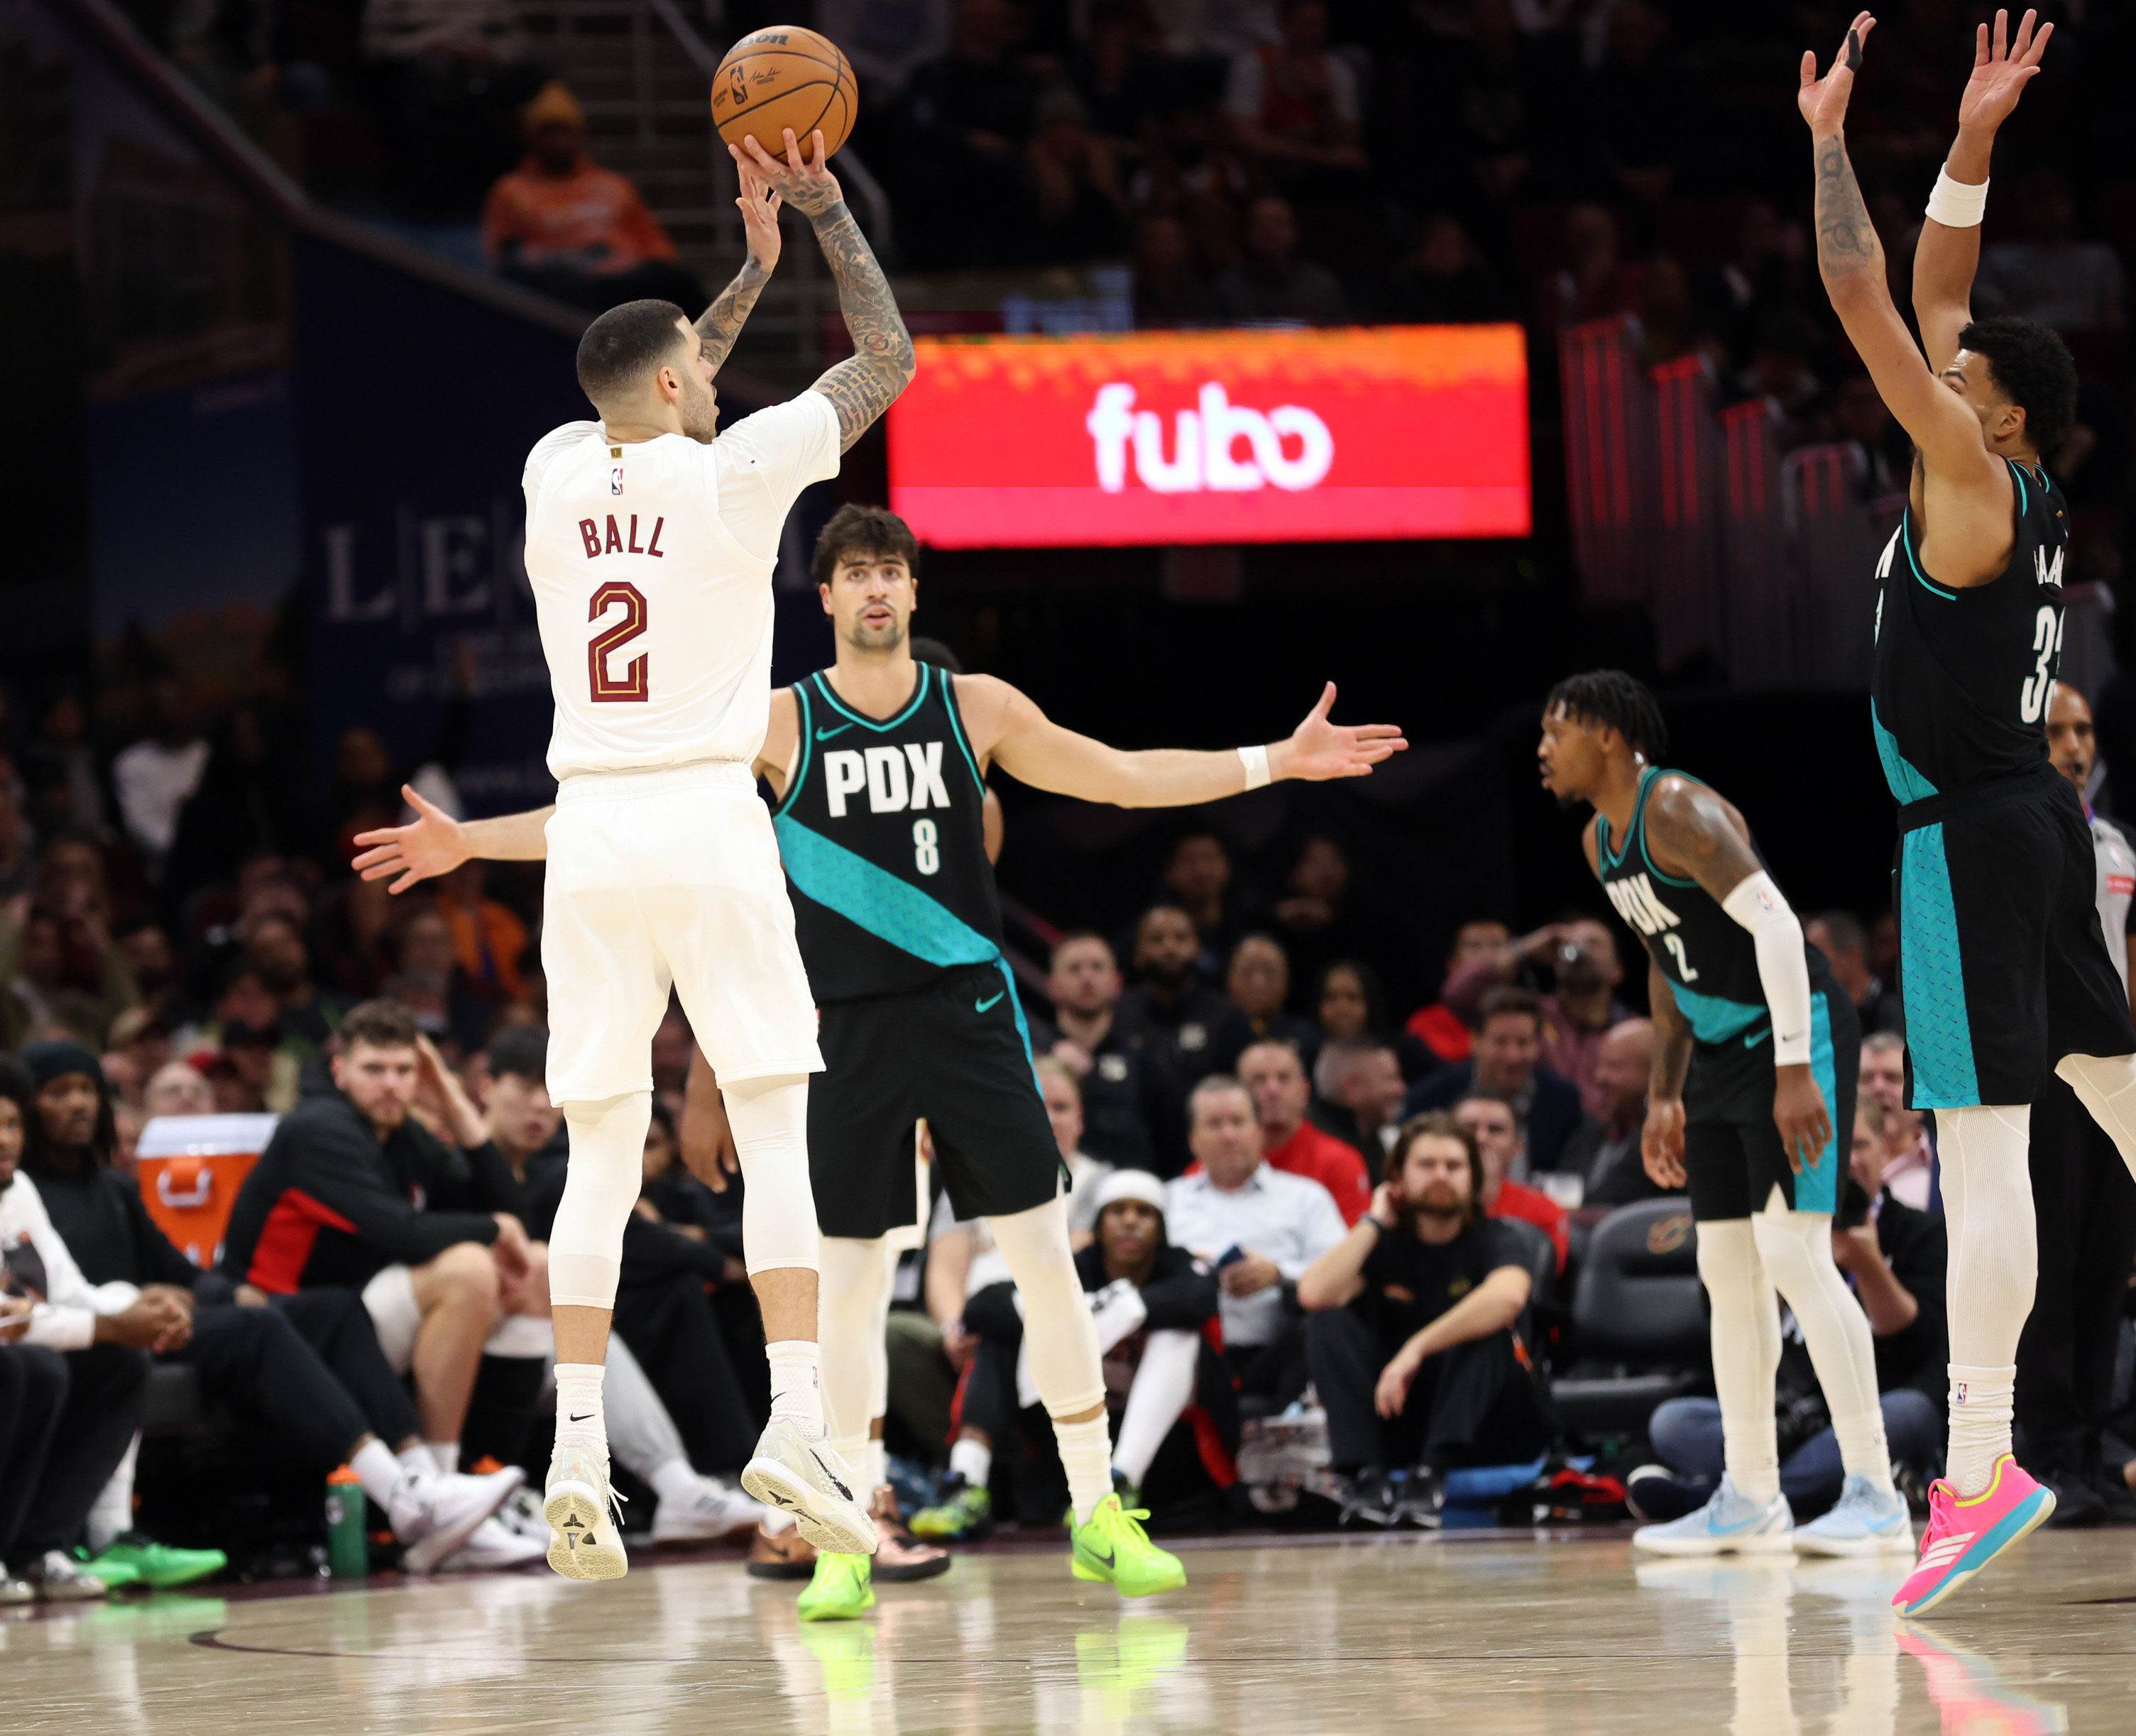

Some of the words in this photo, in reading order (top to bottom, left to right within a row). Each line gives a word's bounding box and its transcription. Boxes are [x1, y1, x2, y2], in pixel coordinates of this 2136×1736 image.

[1087, 382, 1335, 493] fubo
[579, 514, 664, 559] BALL
[588, 581, 649, 703] 2
[823, 741, 951, 818] PDX
[912, 818, 940, 876] 8
[1605, 872, 1682, 936] PDX
[1663, 933, 1699, 983] 2
